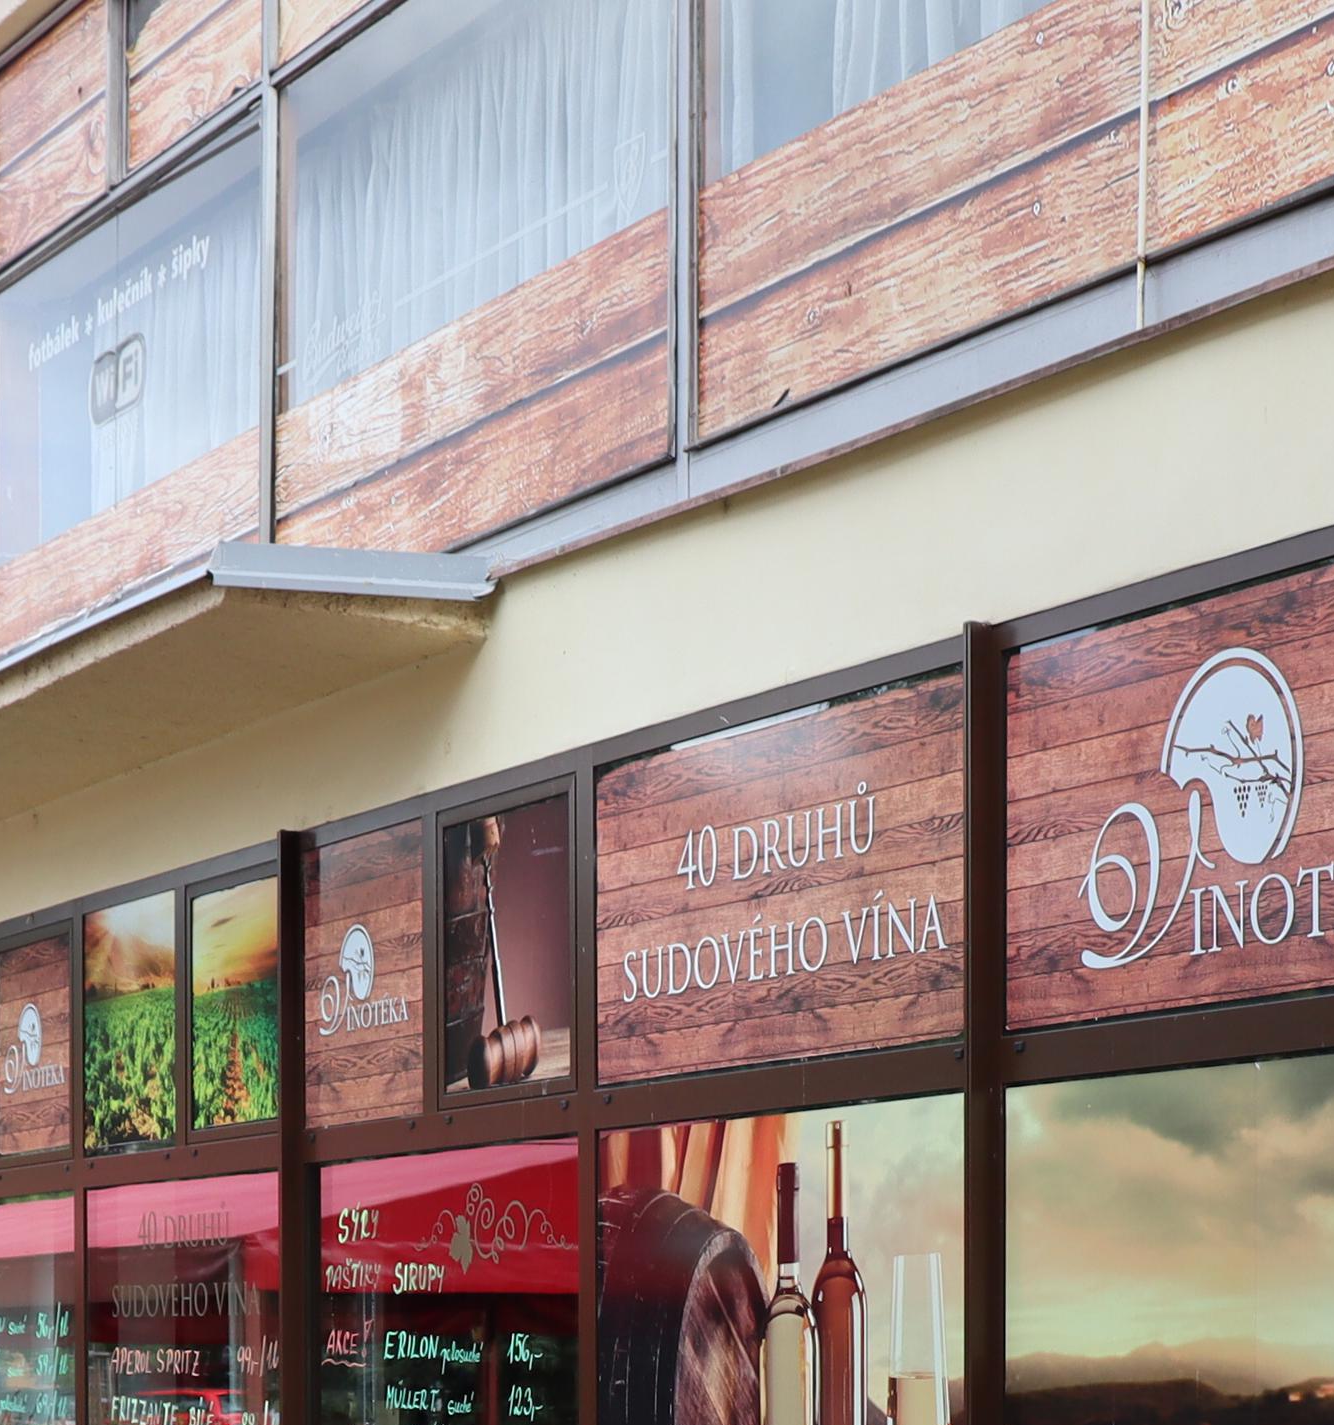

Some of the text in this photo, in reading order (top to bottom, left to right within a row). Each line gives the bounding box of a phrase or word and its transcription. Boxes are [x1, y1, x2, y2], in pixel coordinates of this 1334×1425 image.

[29, 235, 210, 372] fotbálek kulečník šipky
[677, 780, 876, 890] 40 DRUHŮ
[623, 889, 949, 1003] SUDOVÉHO VÍNA
[319, 971, 409, 1036] VINOTÉKA
[138, 1201, 230, 1250] 40 DRUHŮ
[338, 1201, 380, 1244] SÝRY
[111, 1272, 261, 1318] SUDOVÉHO VÍNA
[325, 1257, 445, 1295] PAŠTIKY SIRUPY
[111, 1346, 152, 1376] APEROL
[156, 1348, 200, 1377] SPRITZ
[383, 1330, 440, 1361] ERILON
[507, 1332, 544, 1371] 156,-
[508, 1384, 544, 1423] 123,-
